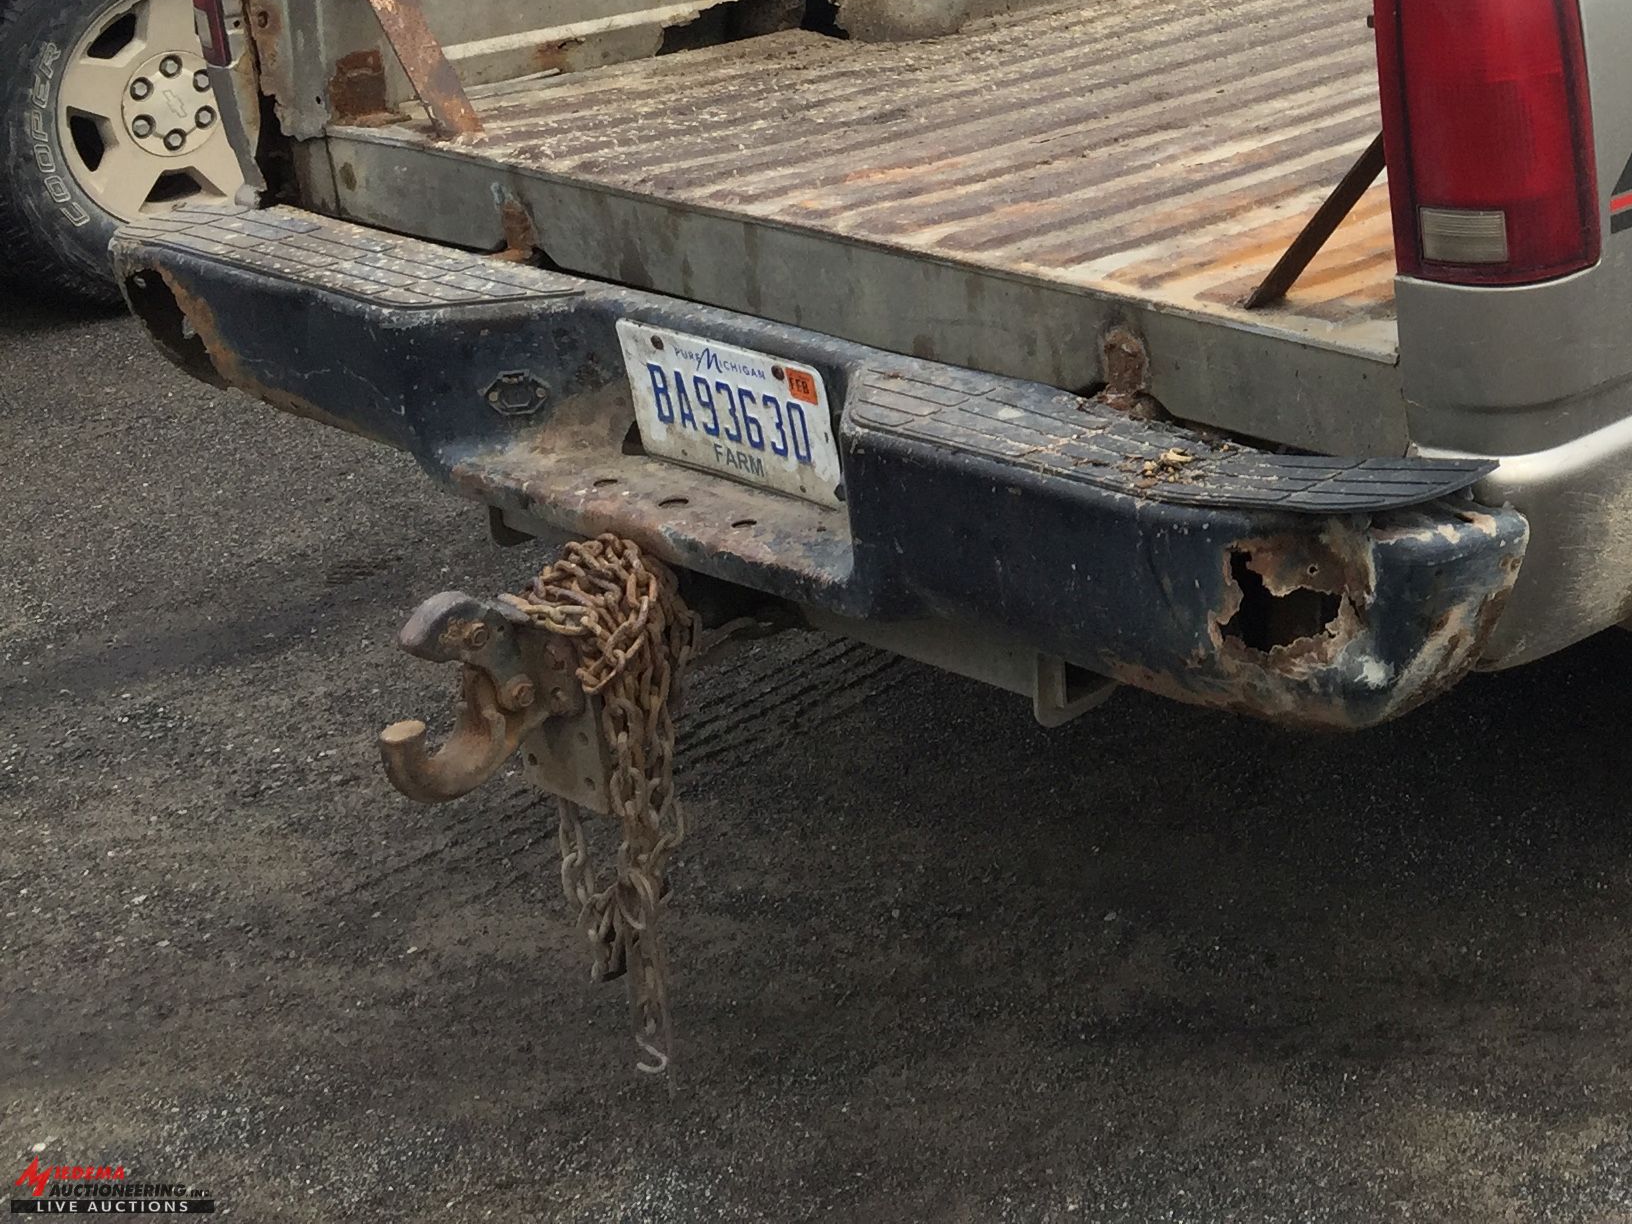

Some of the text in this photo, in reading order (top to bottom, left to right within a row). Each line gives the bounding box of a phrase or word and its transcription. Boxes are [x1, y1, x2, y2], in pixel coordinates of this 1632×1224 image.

[31, 42, 91, 227] COOPER
[673, 347, 701, 362] PURE
[789, 377, 810, 395] FEB
[647, 363, 812, 465] BA93630
[713, 443, 765, 478] FARM
